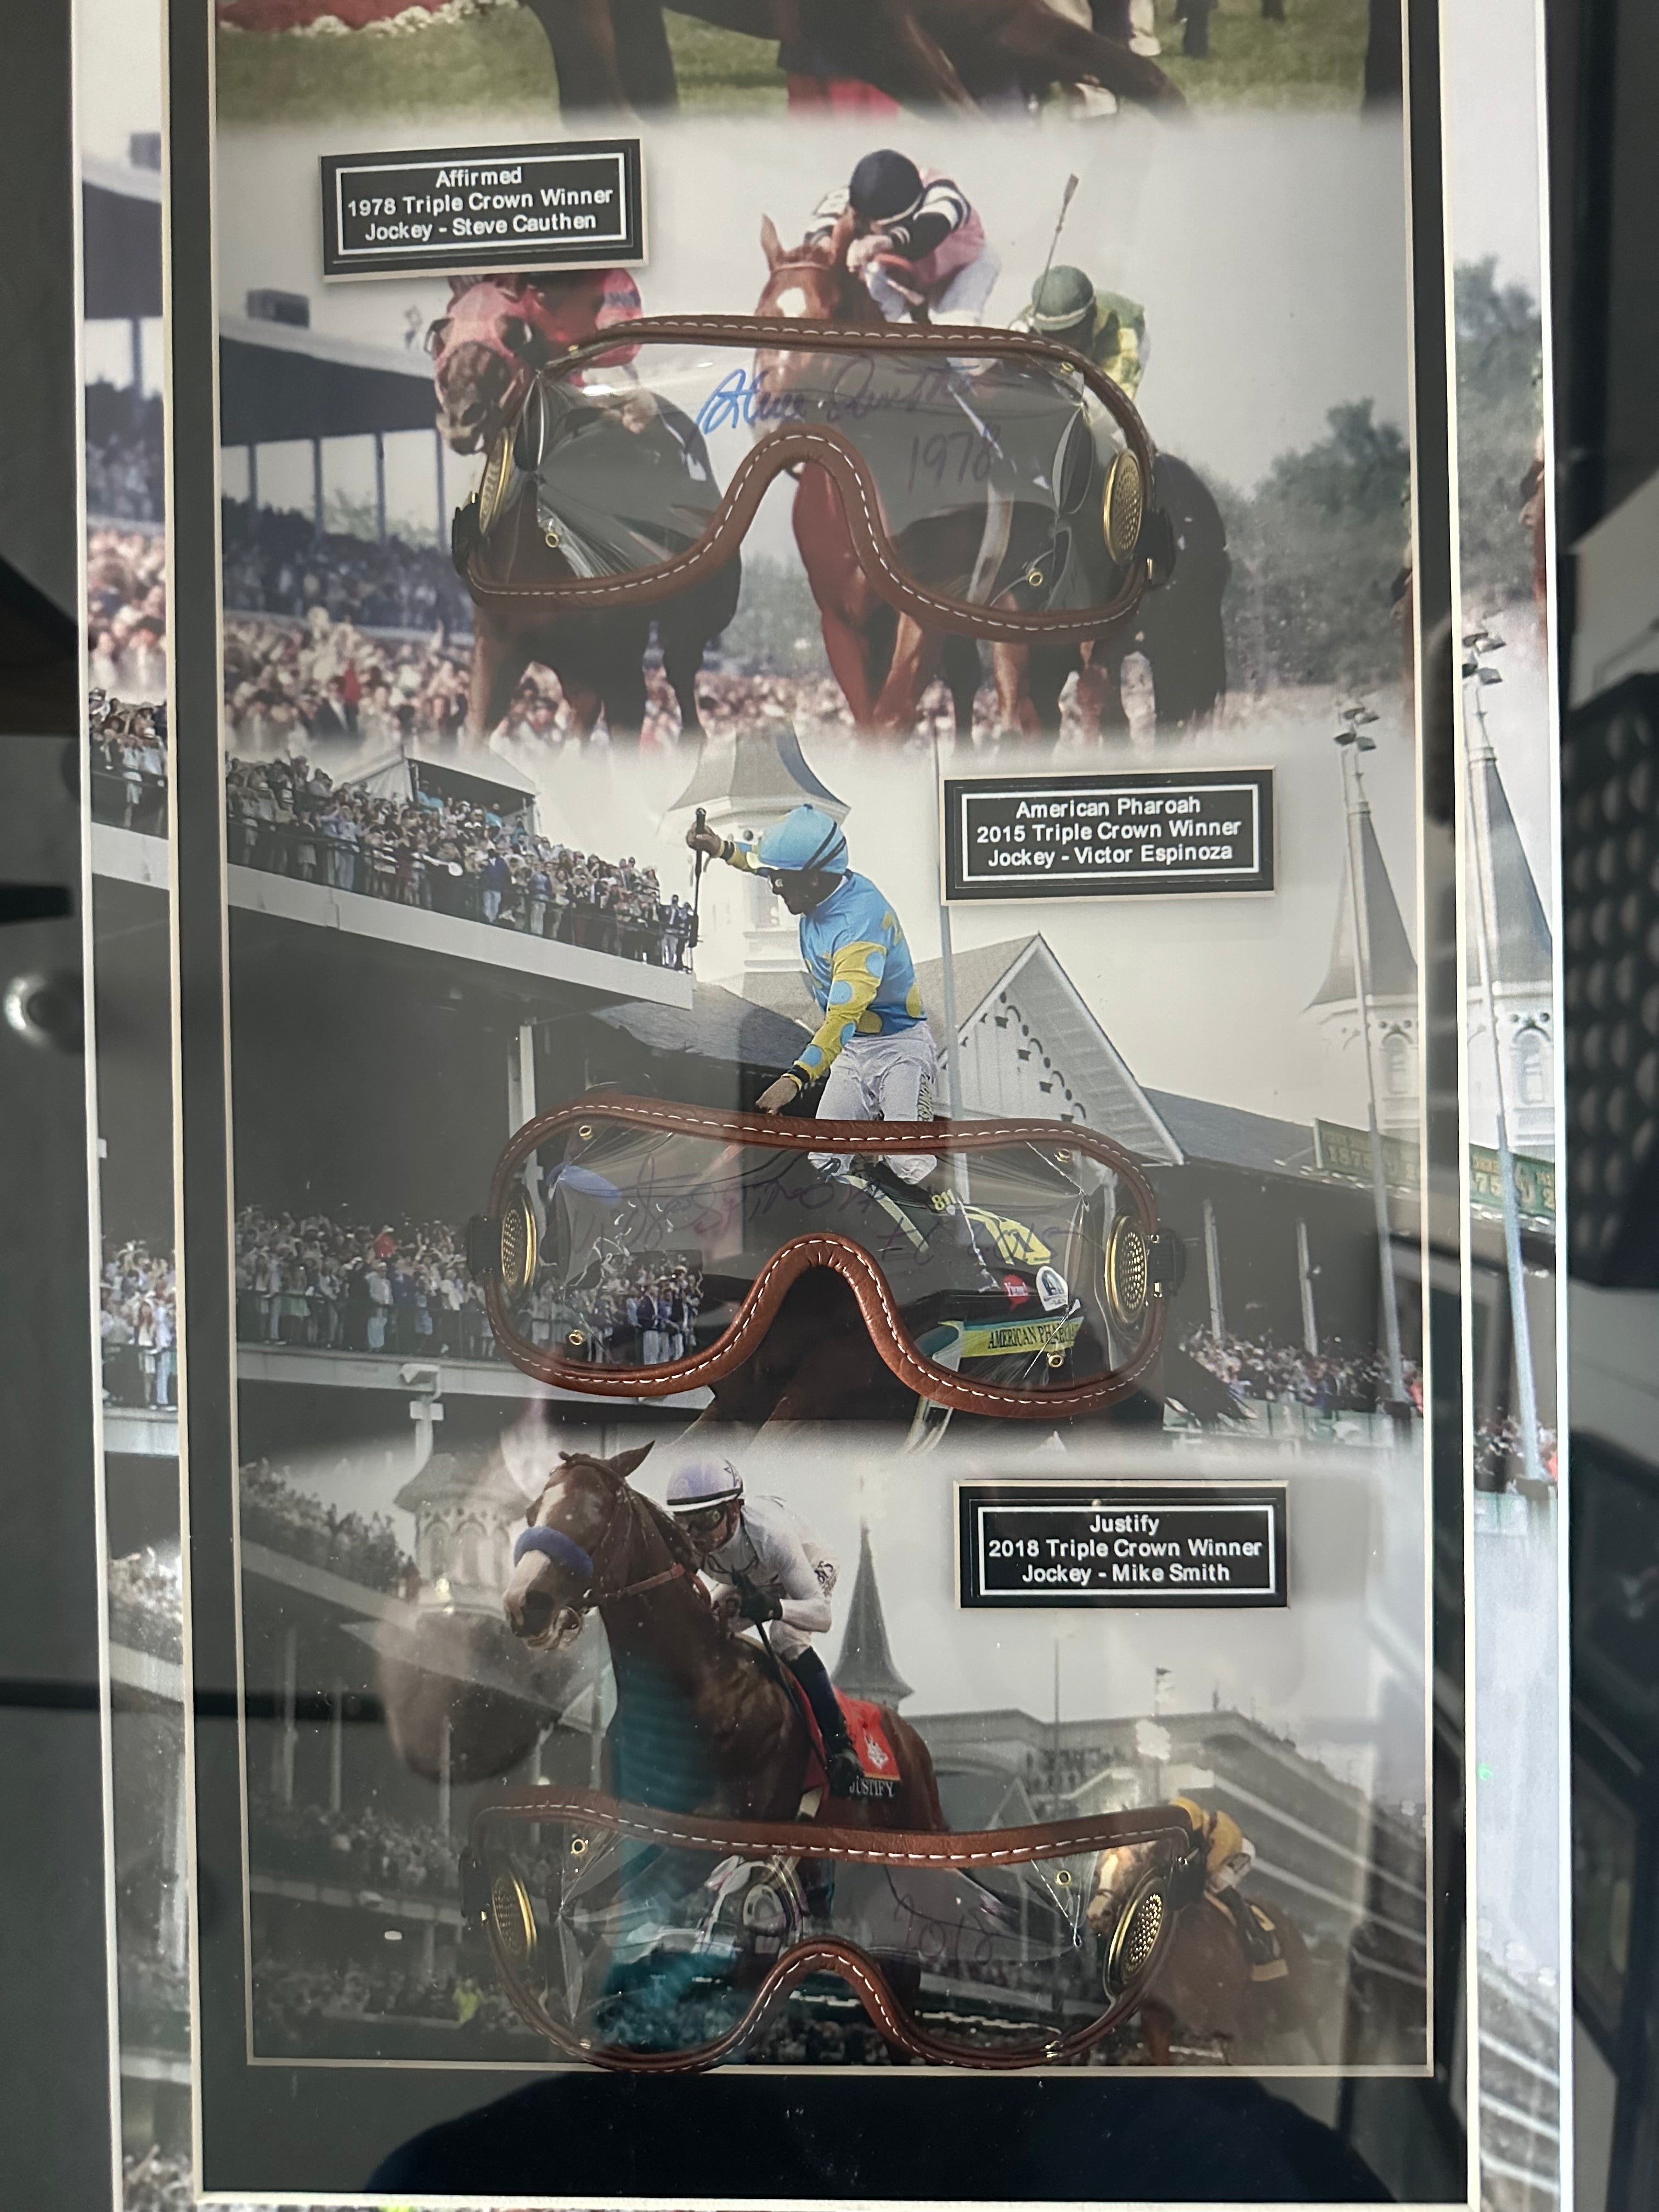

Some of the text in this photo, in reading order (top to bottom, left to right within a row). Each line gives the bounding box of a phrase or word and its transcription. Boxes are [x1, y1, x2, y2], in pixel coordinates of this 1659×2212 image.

[436, 166, 522, 188] Affirmed
[348, 188, 613, 216] 1978 Triple Crown Winner
[365, 222, 432, 241] Jockey
[453, 218, 507, 236] Steve
[513, 213, 596, 232] Cauthen
[1016, 796, 1200, 819] American Pharoah
[977, 820, 1242, 845] 2015 Triple Crown Winner
[989, 849, 1055, 869] Jockey
[1074, 847, 1133, 864] Victor
[1141, 843, 1232, 865] Espinoza
[988, 1325, 1037, 1348] AMERICAN
[1090, 1514, 1159, 1536] Justify
[989, 1539, 1262, 1560] 2018 Triple Crown Winner
[1023, 1564, 1091, 1586] Jockey
[1113, 1564, 1164, 1582] Mike
[1170, 1564, 1229, 1582] Smith
[849, 1775, 895, 1799] JUSTIFY
